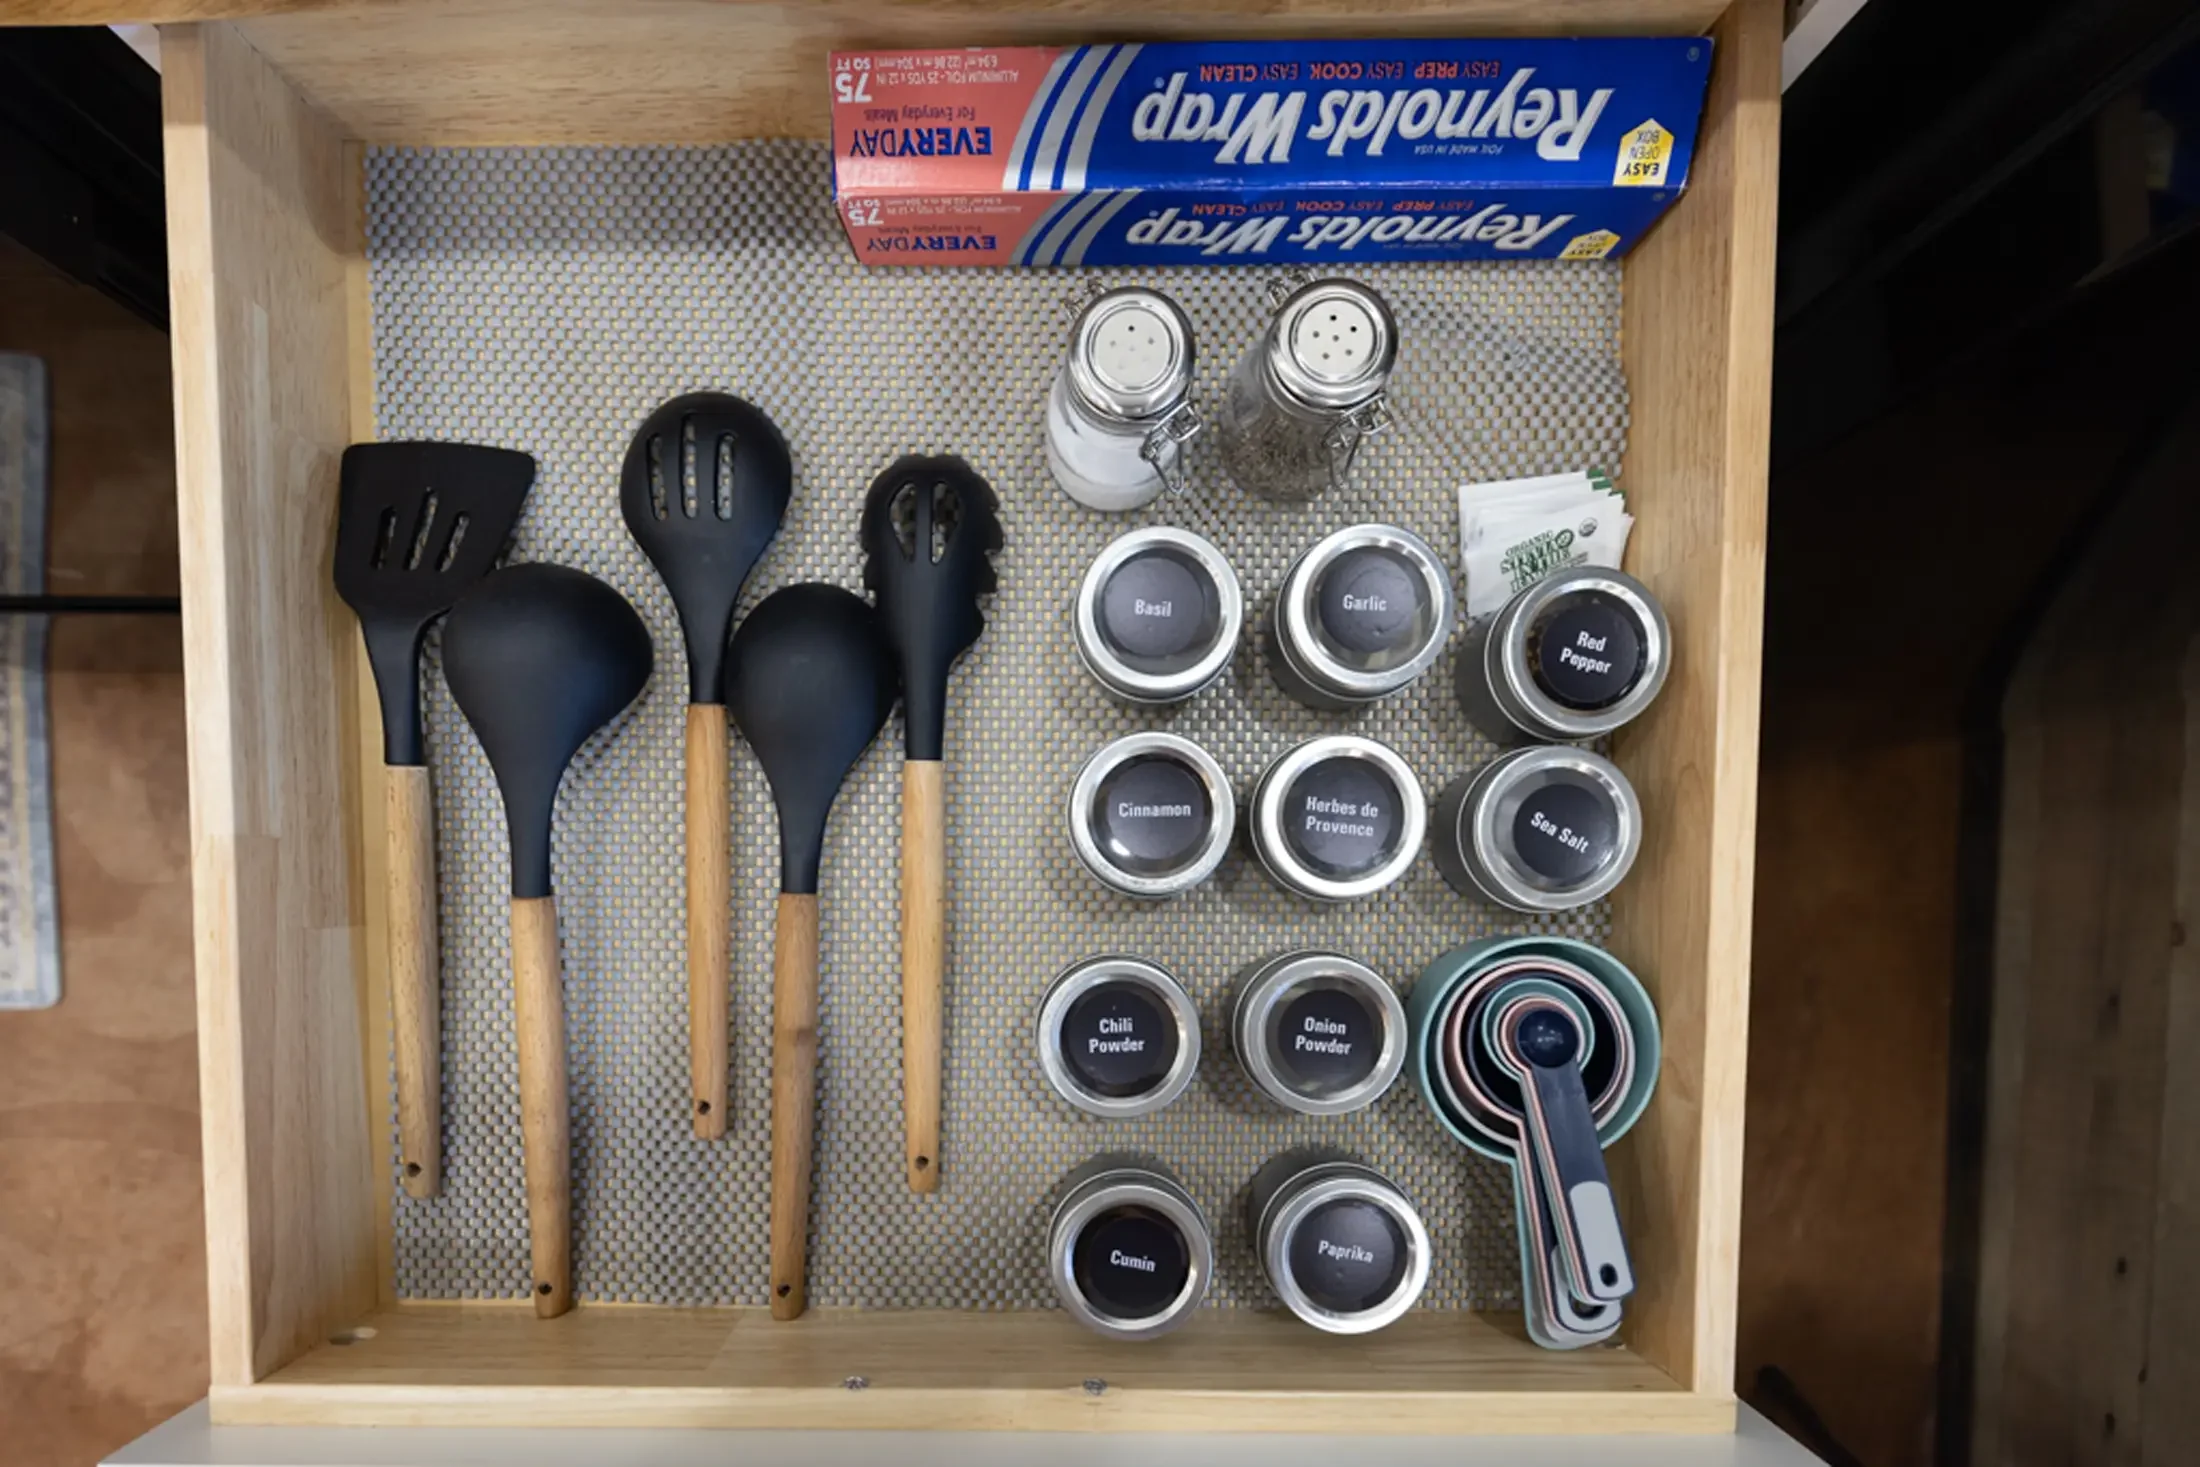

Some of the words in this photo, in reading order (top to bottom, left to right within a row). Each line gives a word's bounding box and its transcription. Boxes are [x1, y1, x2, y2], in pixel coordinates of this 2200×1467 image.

[835, 57, 850, 71] FT
[1261, 63, 1299, 80] EASY
[1366, 62, 1404, 79] EASY
[1462, 61, 1500, 78] EASY
[835, 72, 872, 103] 75
[902, 105, 953, 122] Everyday
[957, 107, 975, 121] For
[1131, 71, 1307, 164] Wrap
[1306, 67, 1615, 161] Reynolds
[850, 126, 993, 157] EVERYDAY
[1636, 130, 1660, 144] BOX
[1414, 143, 1434, 154] USA
[1435, 143, 1447, 154] IN
[1449, 143, 1479, 154] MADE
[1629, 146, 1660, 160] OPEN
[1622, 162, 1660, 177] EASY
[848, 207, 884, 227] 75
[1286, 203, 1577, 250] Reynolds
[1125, 208, 1289, 256] Wrap
[866, 235, 997, 252] EVERYDAY
[1134, 598, 1172, 617] Basil
[1343, 594, 1387, 613] Garlic
[1576, 630, 1607, 652] Red
[1560, 646, 1612, 674] Pepper
[1118, 802, 1191, 818] Cinnamon
[1306, 795, 1357, 816] Herbes
[1360, 801, 1379, 818] de
[1305, 815, 1375, 837] Provence
[1530, 811, 1558, 837] Sea
[1558, 827, 1589, 854] Salt
[1099, 1017, 1133, 1034] Chili
[1303, 1016, 1347, 1035] Onion
[1088, 1035, 1145, 1054] Powder
[1295, 1034, 1351, 1056] Powder
[1110, 1249, 1156, 1272] Cumin
[1318, 1240, 1374, 1264] Paprika
